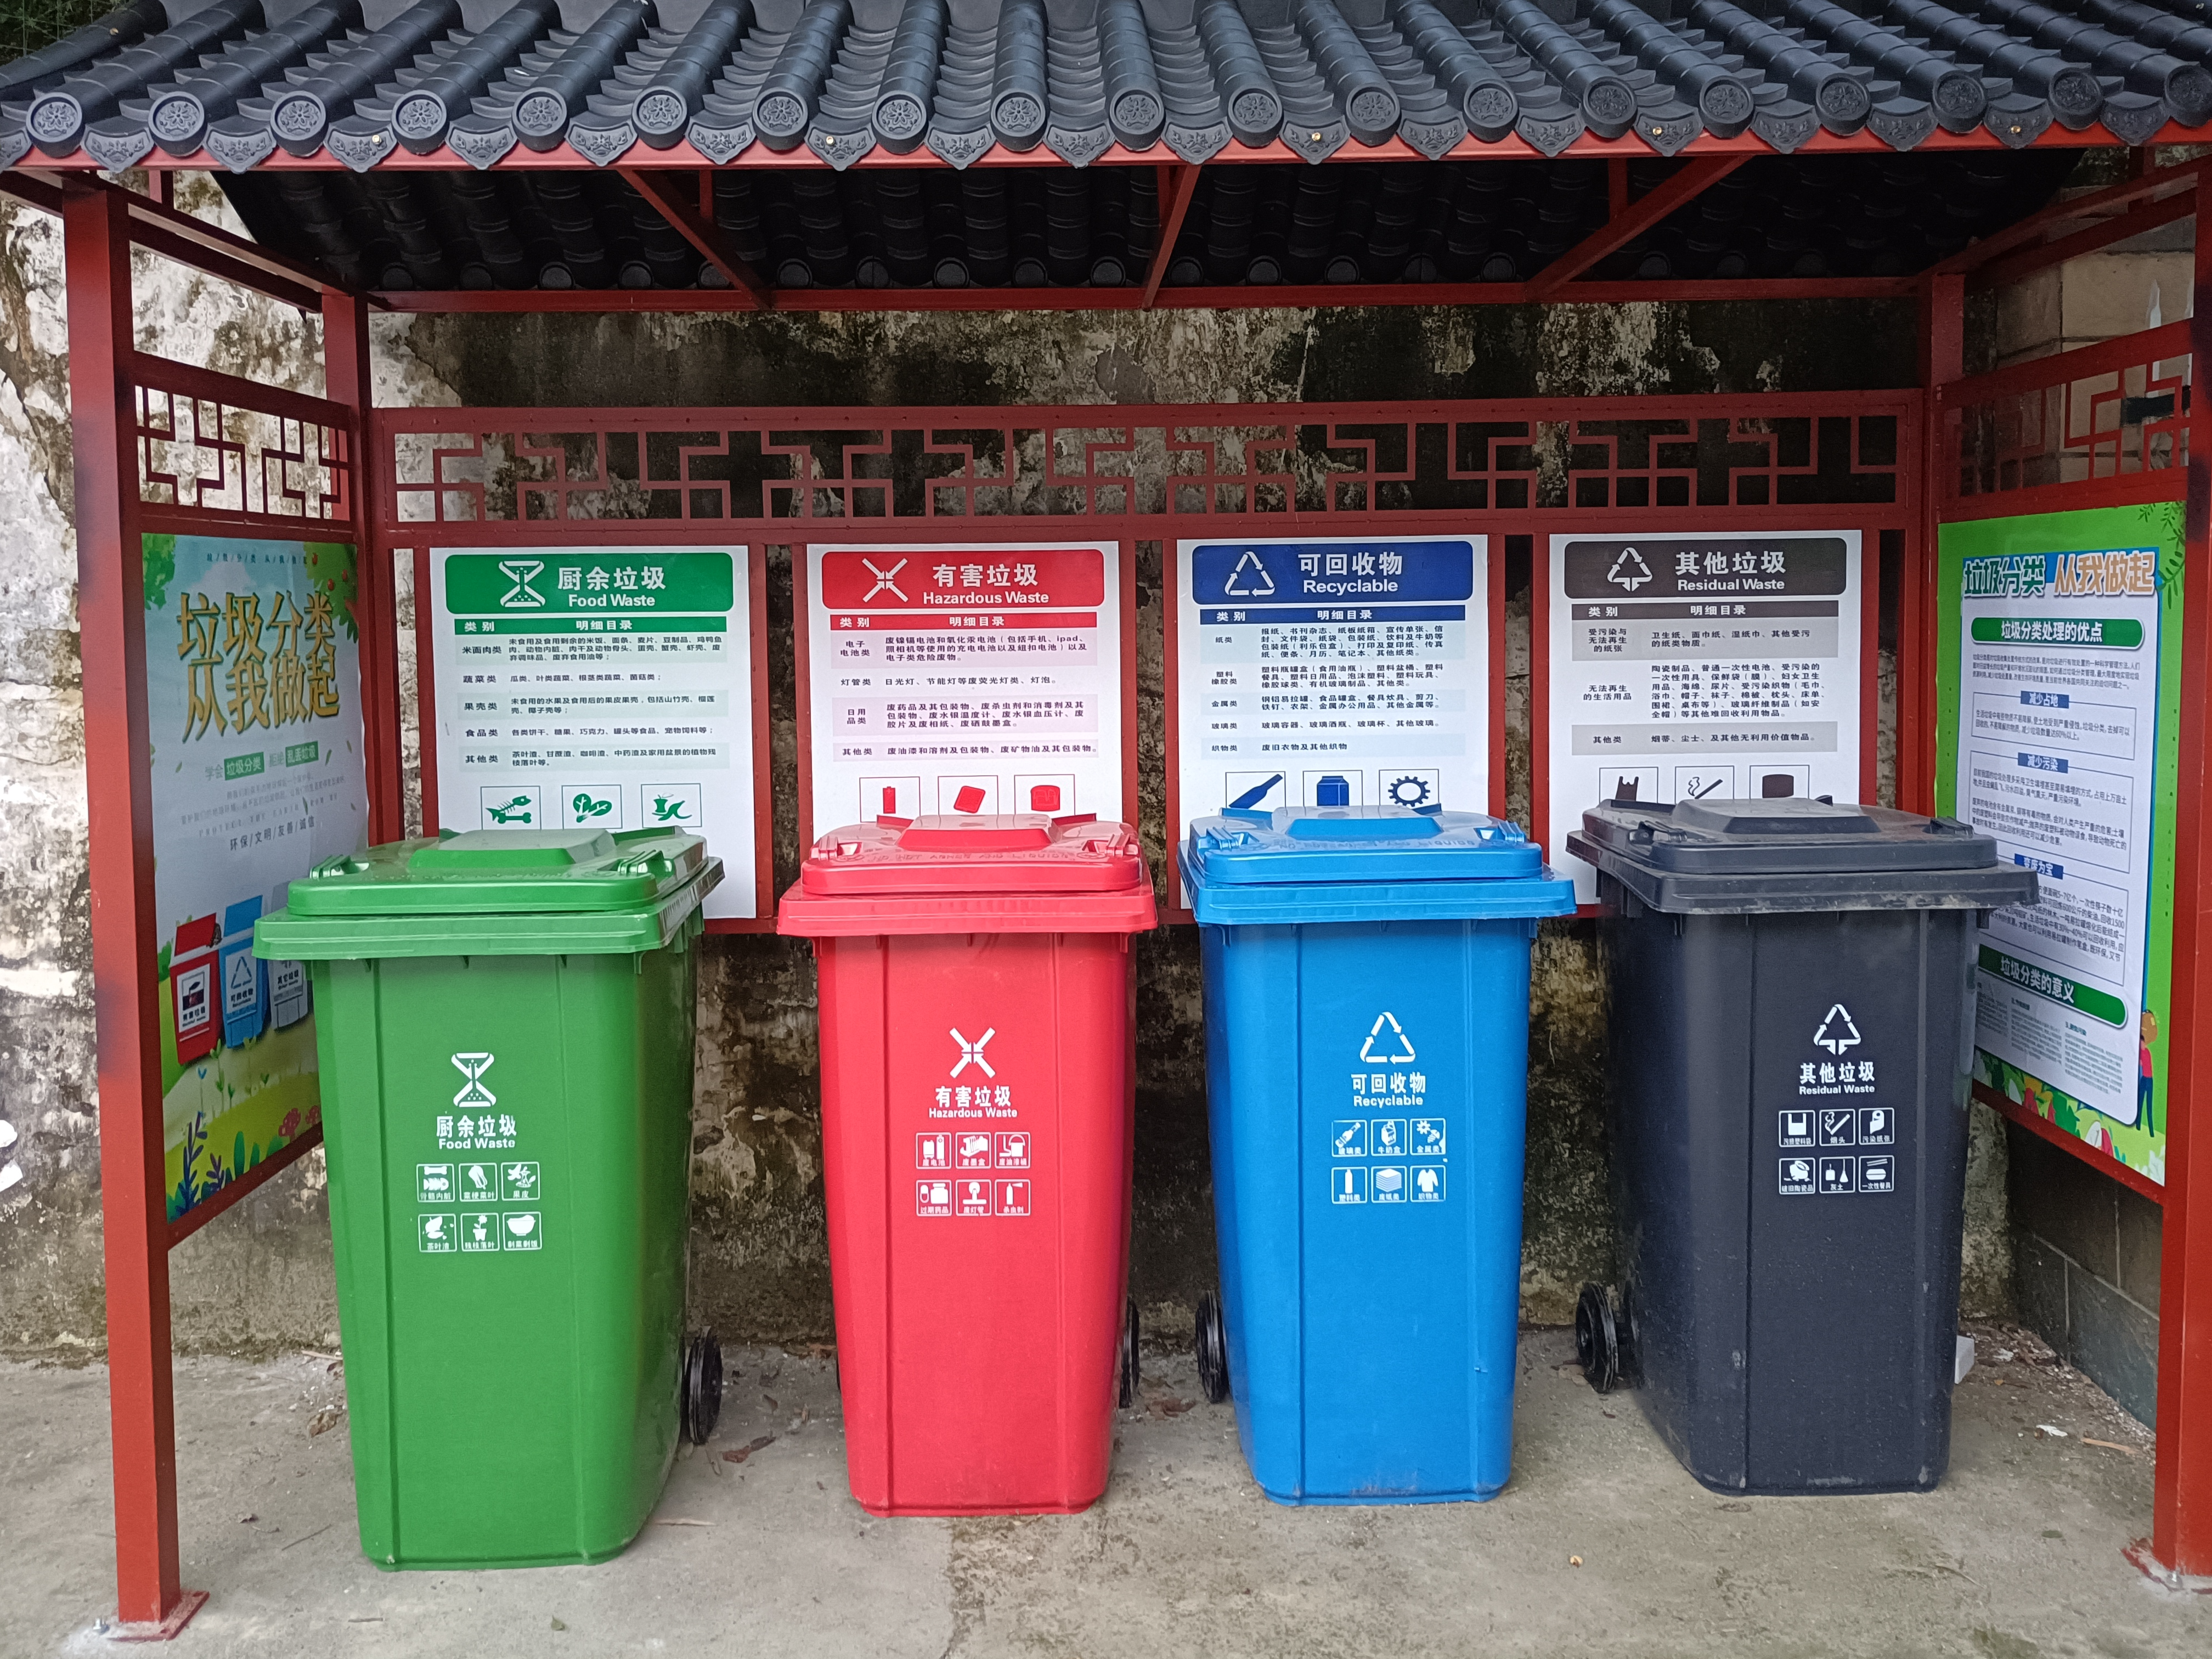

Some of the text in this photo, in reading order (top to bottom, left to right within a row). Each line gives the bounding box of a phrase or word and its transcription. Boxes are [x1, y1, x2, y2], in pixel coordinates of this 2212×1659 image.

[1298, 552, 1402, 576] 可回收物
[1675, 551, 1786, 575] 其他垃圾
[557, 566, 666, 591] 厨余垃圾
[933, 563, 1038, 587] 有害垃圾
[1964, 551, 2154, 596] 垃圾分类 从我做起
[1304, 579, 1398, 596] Recyclable
[1678, 579, 1785, 591] Residual Waste
[568, 594, 655, 607] Food Waste
[923, 591, 1049, 605] Hazardous Waste
[1217, 611, 1245, 622] 类别
[1317, 610, 1372, 620] 明细目录
[1588, 606, 1618, 617] 类别
[1690, 605, 1746, 616] 明细目录
[176, 590, 335, 665] 垃圾分类
[465, 622, 494, 631] 类别
[576, 620, 632, 630] 明细目录
[840, 617, 870, 628] 类别
[950, 616, 1005, 627] 明细目录
[1651, 630, 1810, 639] 卫生纸、面巾纸、湿纸巾、其他受污
[2001, 622, 2103, 642] 垃圾分类处理的优点
[182, 645, 339, 743] 从我做起
[2028, 692, 2058, 707] 减少占地
[1262, 743, 1347, 751] 废旧衣物及其他织物
[226, 756, 262, 776] 垃圾分类
[2027, 755, 2058, 771] 减少污染
[2024, 857, 2053, 876] 变废为宝
[2001, 956, 2074, 1003] 垃圾分类的意义
[1799, 1061, 1875, 1084] 其他垃圾
[1351, 1072, 1426, 1094] 可回收物
[1799, 1085, 1875, 1095] Residual Waste
[935, 1086, 1011, 1108] 有害垃圾
[1353, 1095, 1423, 1108] Recyclable
[929, 1107, 1018, 1118] Hazardous Waste
[436, 1114, 517, 1138] 厨余垃圾
[439, 1138, 515, 1149] Food Waste
[1378, 1146, 1401, 1154] 牛奶盒
